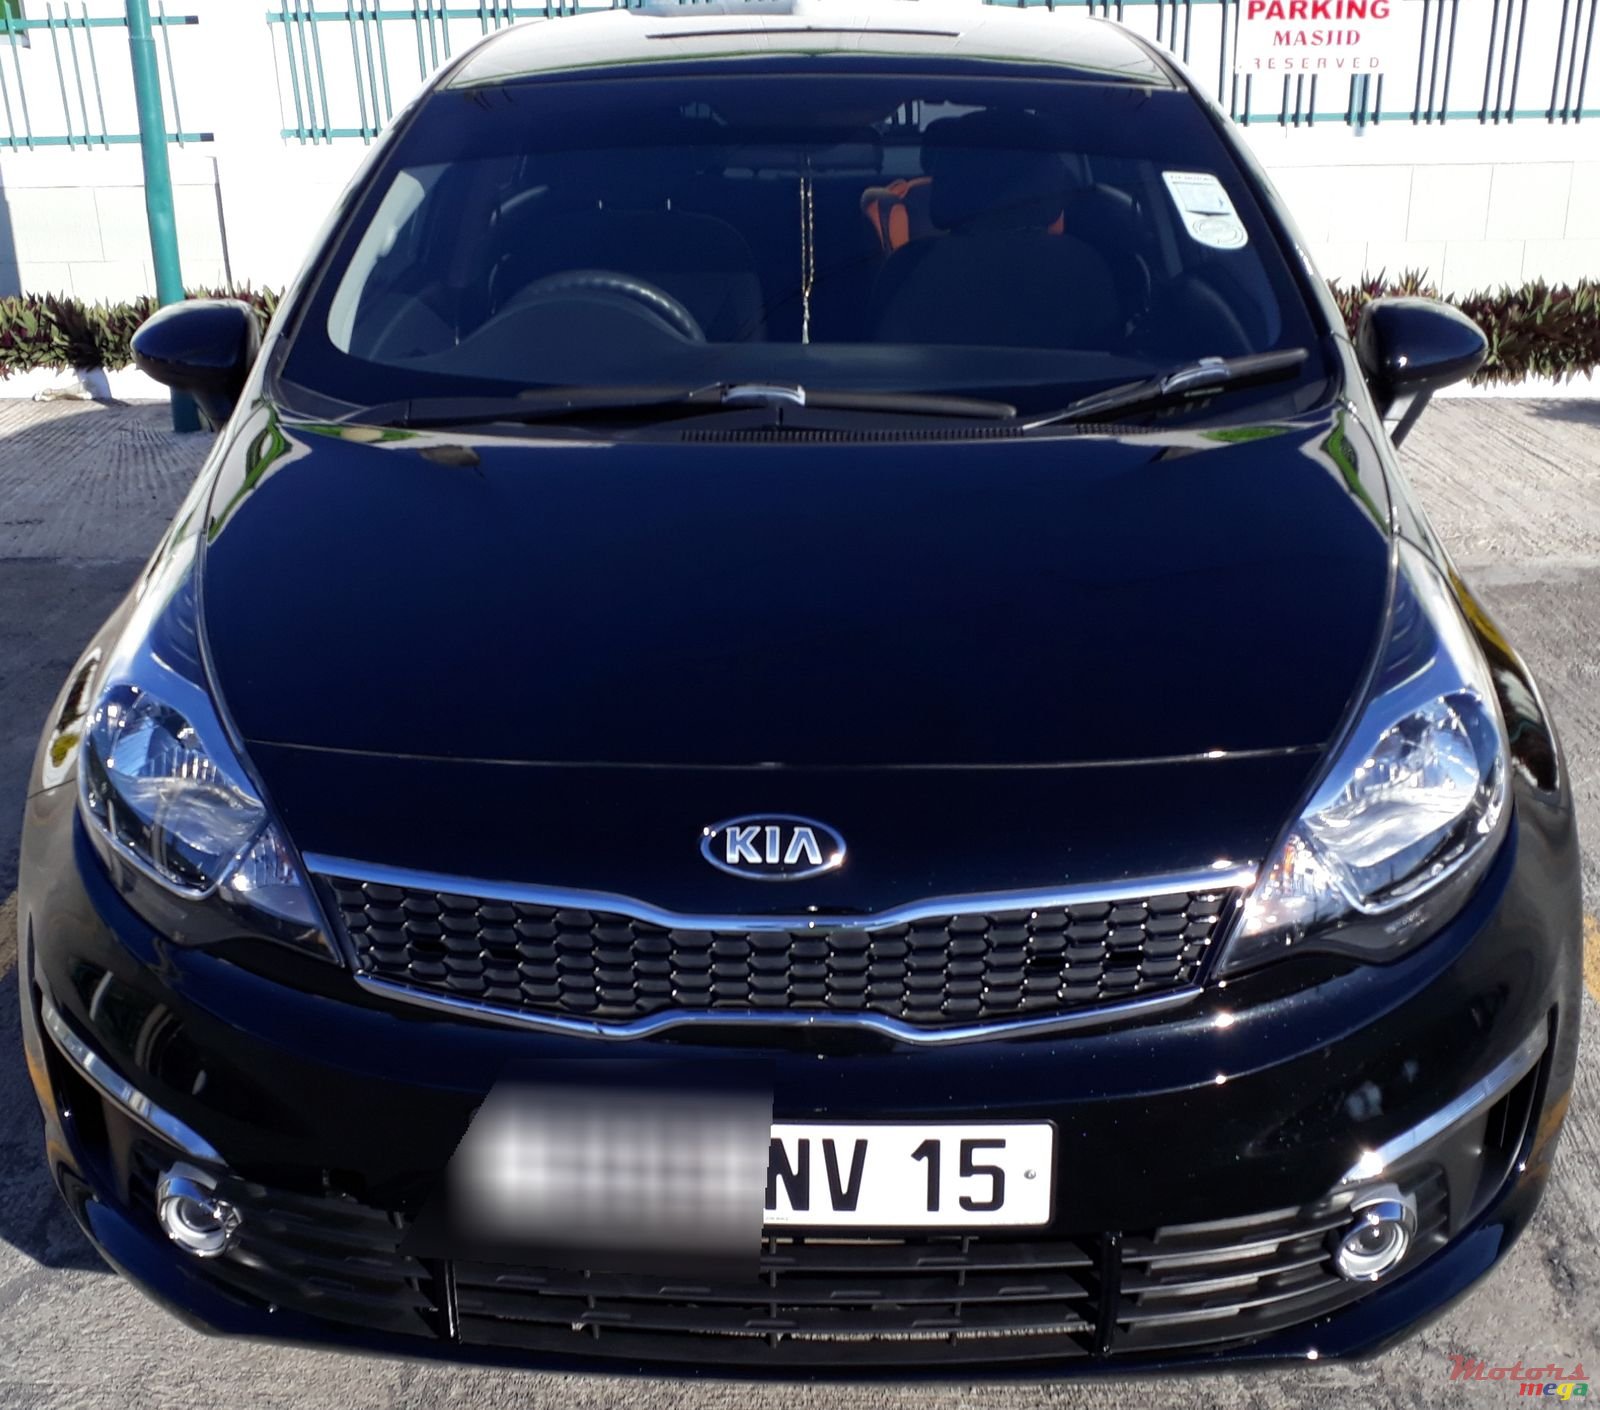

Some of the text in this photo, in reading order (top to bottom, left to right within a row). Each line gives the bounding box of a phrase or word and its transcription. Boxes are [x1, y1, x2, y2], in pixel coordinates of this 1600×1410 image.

[1247, 0, 1390, 20] PARKING
[1273, 30, 1361, 46] MASJID
[1254, 57, 1380, 69] RESERVED
[726, 826, 823, 865] KIA
[765, 1138, 1006, 1212] NV 15
